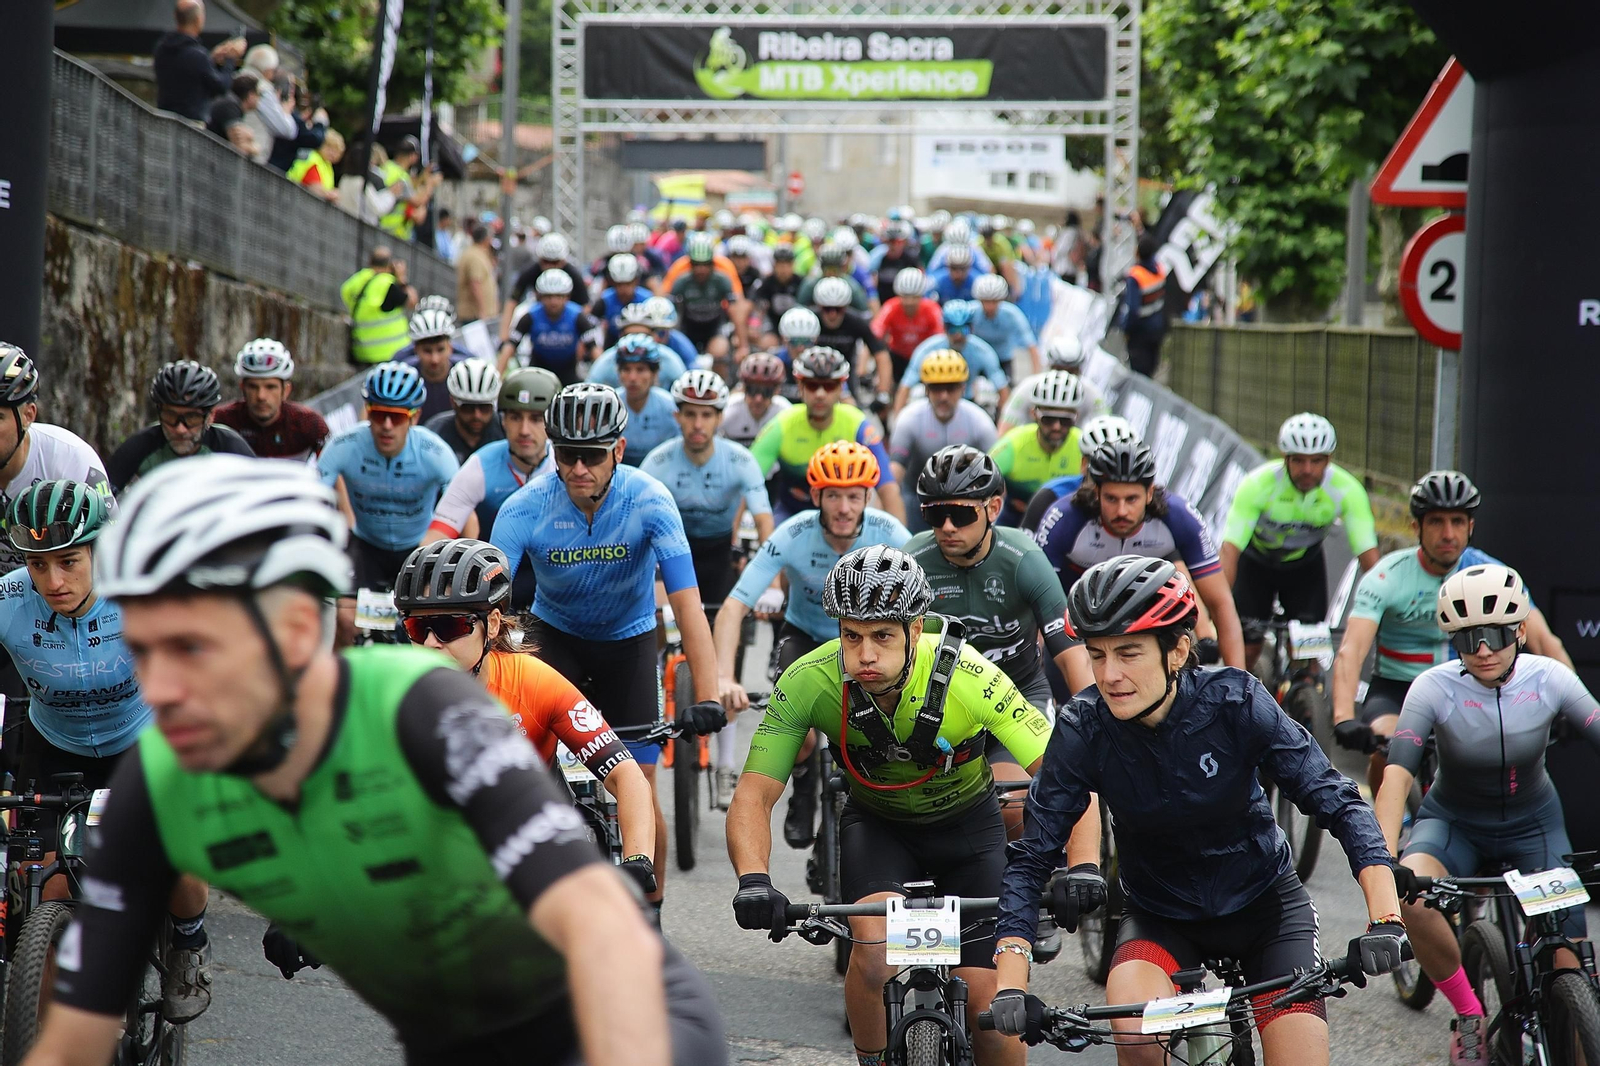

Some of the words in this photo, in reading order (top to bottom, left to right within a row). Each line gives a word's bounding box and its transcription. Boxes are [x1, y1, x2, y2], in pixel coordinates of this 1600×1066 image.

[758, 31, 863, 61] Ribeira
[867, 31, 954, 61] Sacra
[758, 65, 824, 91] MTB
[830, 65, 979, 96] Xperience
[550, 545, 627, 563] CLICKPISO
[364, 605, 394, 619] 157
[1533, 880, 1567, 898] 18
[905, 928, 942, 950] 59
[1174, 1002, 1195, 1016] 2
